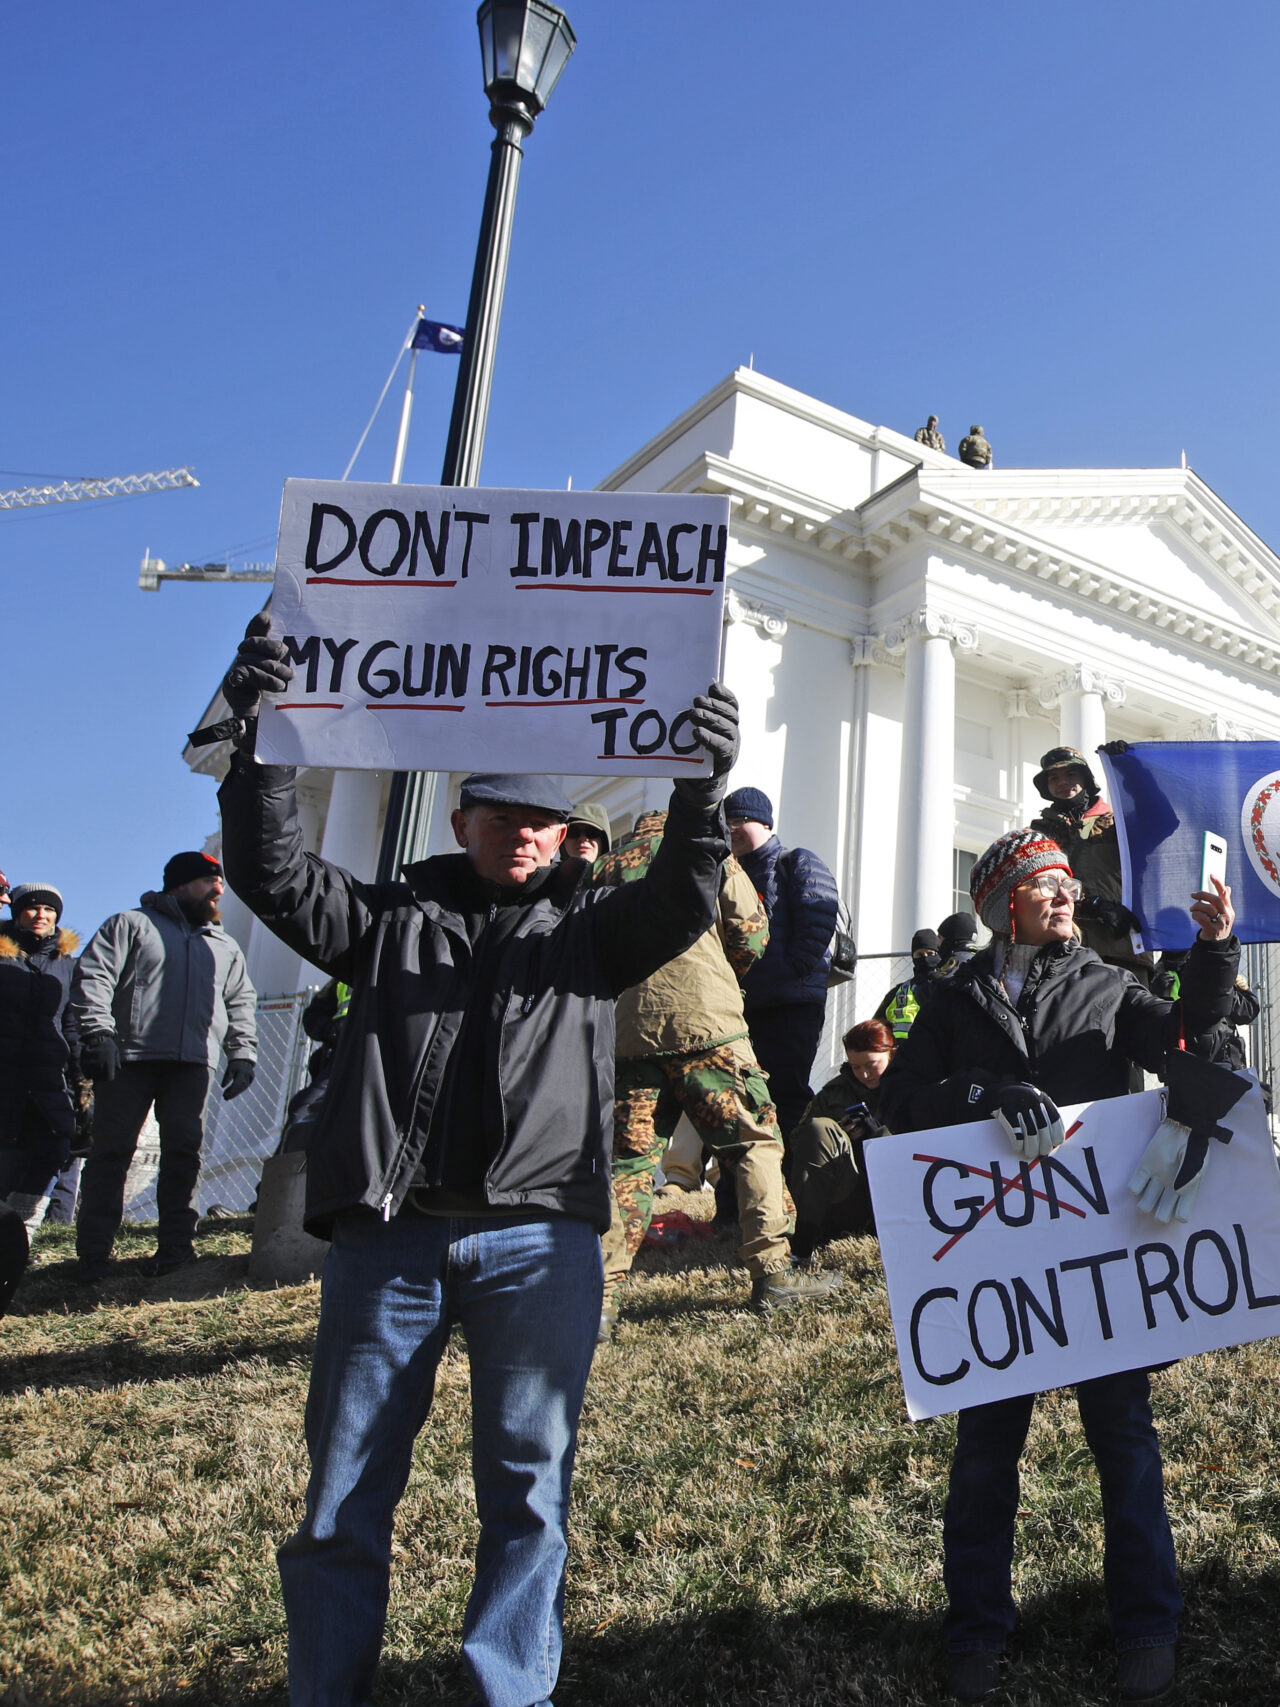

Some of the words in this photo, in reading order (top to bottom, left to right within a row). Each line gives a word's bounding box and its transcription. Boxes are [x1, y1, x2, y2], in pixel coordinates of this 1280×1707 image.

[305, 502, 490, 578] DON'T
[510, 512, 727, 584] IMPEACH
[280, 635, 359, 693] MY
[357, 640, 471, 698] GUN
[482, 644, 647, 699] RIGHTS
[591, 707, 702, 755] TOO
[922, 1146, 1110, 1235] GUN
